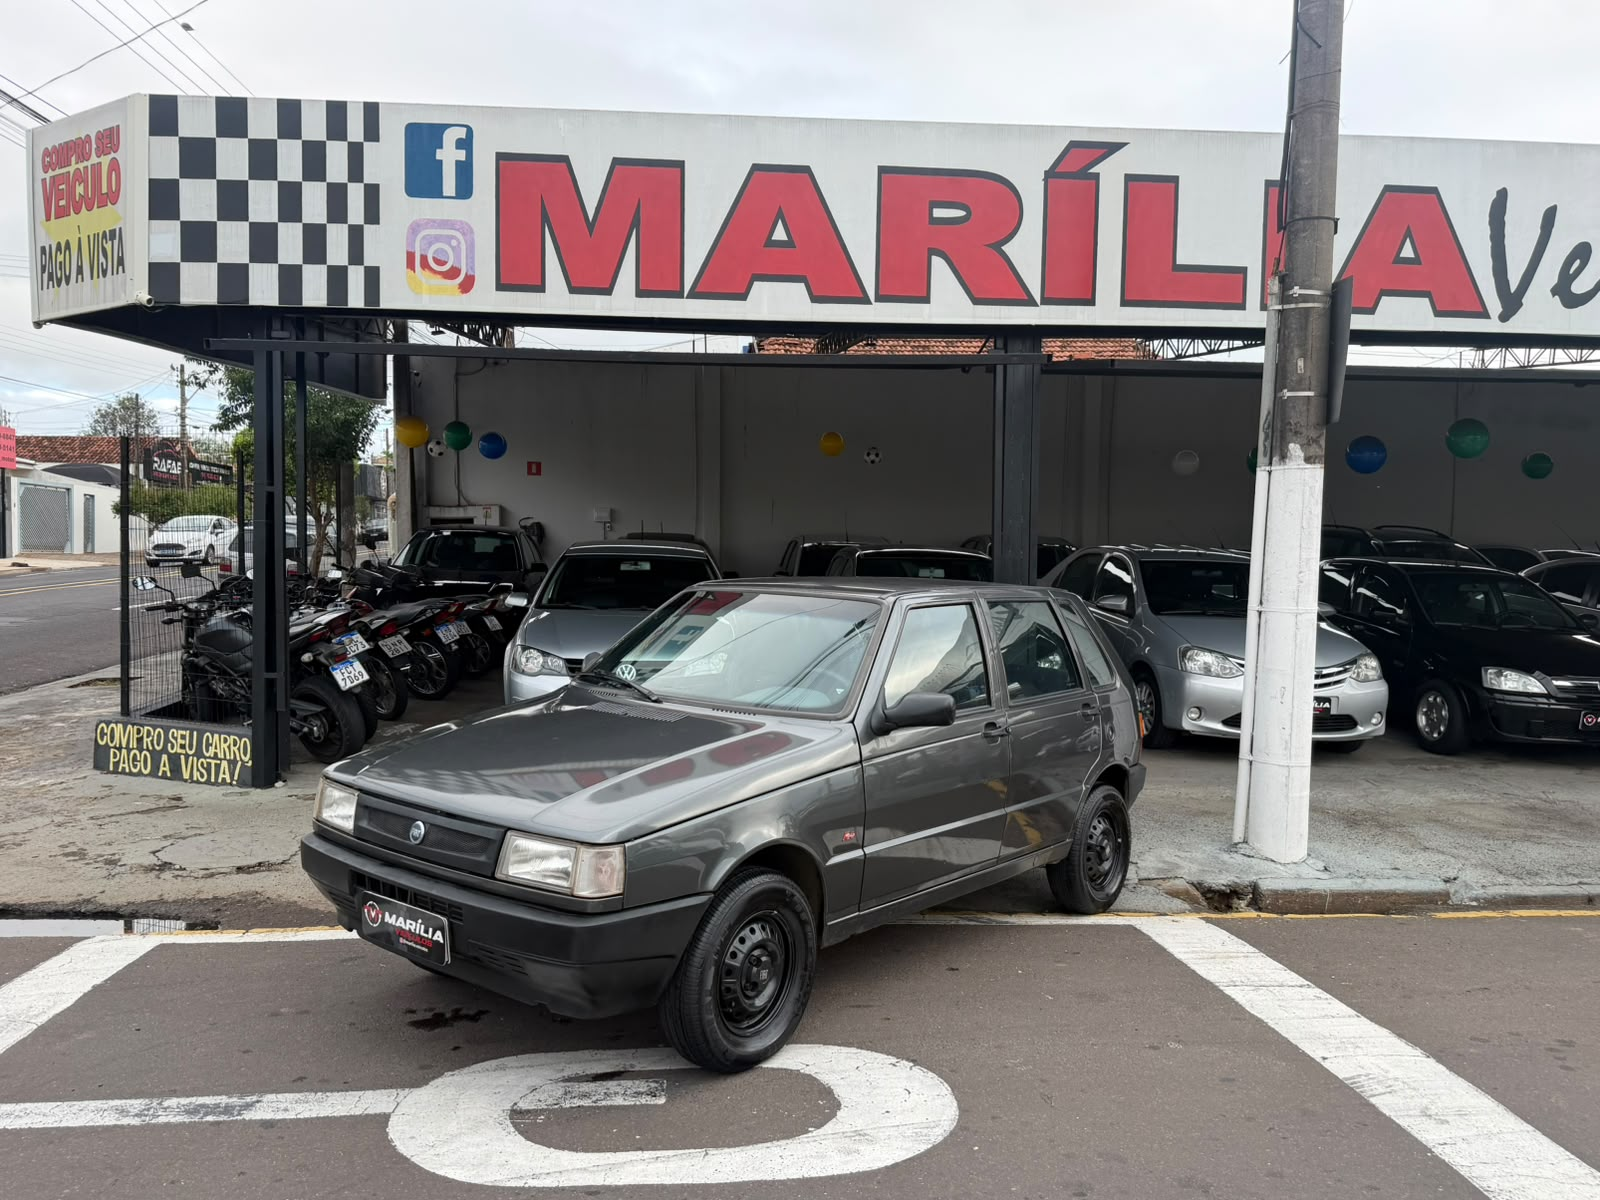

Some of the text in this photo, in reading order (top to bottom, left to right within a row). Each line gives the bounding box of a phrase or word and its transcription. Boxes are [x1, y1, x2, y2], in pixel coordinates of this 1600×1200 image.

[41, 124, 121, 174] COMPRO SEU
[495, 141, 1492, 319] MARÍLA
[40, 225, 125, 291] PAGO À VISTA
[153, 456, 182, 474] RAFAE
[340, 665, 358, 678] FCT
[341, 671, 364, 688] 7D69
[97, 722, 164, 751] COMPRO
[168, 729, 197, 755] SEU
[109, 749, 241, 785] PAGO A VISTA!
[384, 911, 444, 944] MARÍLIA
